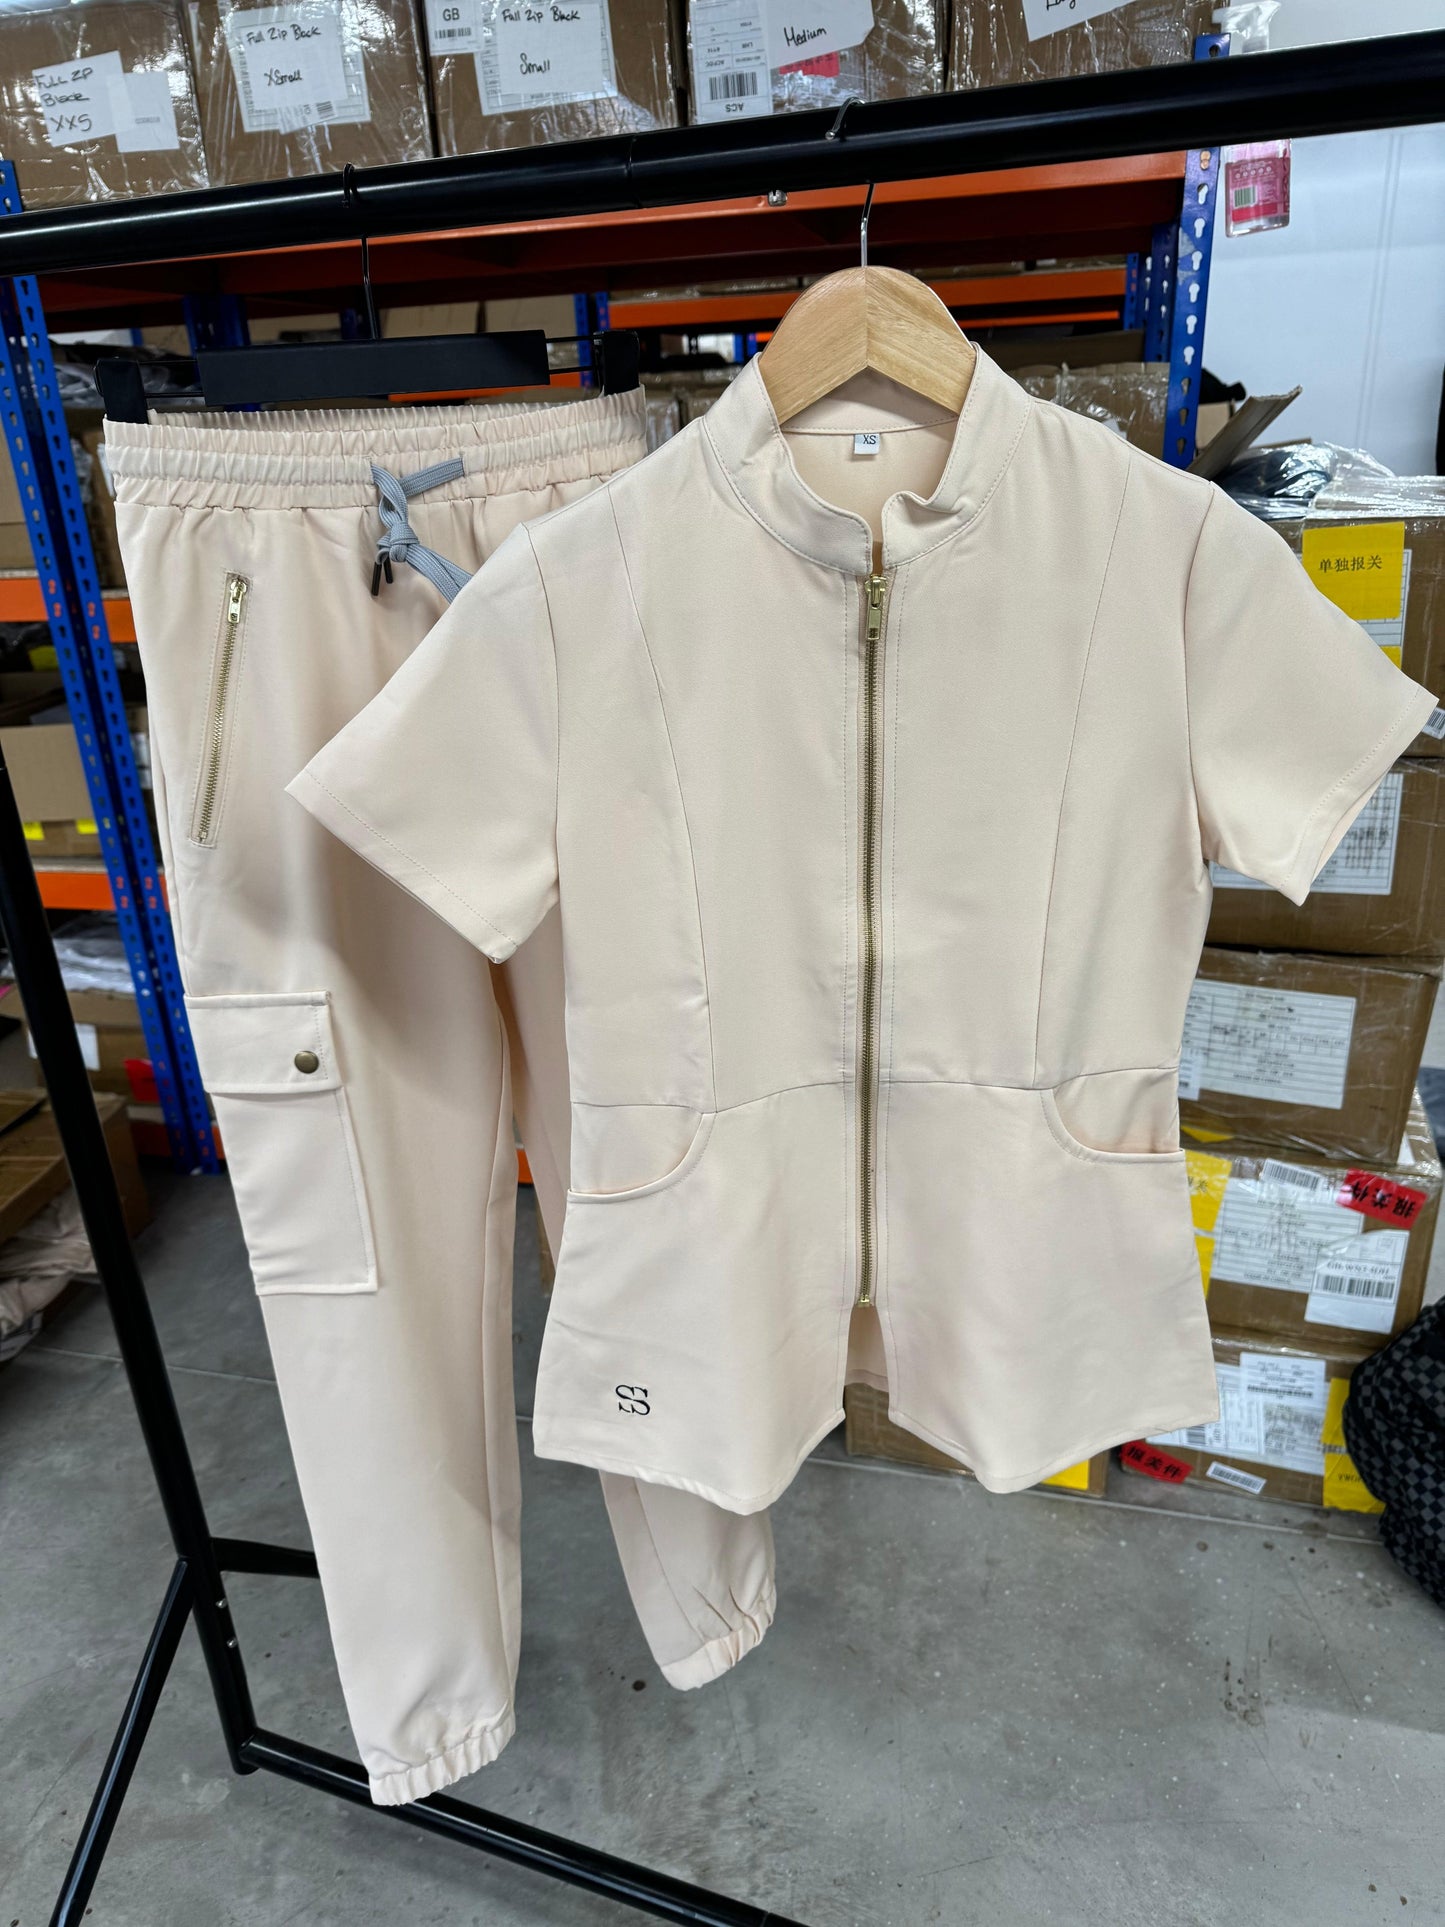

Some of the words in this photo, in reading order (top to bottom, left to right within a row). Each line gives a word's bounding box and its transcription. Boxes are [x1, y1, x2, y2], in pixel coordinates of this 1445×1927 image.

[442, 8, 460, 21] GB
[267, 27, 288, 41] Zip
[784, 26, 827, 47] Medium
[519, 52, 551, 75] Small
[725, 102, 744, 113] ACS
[50, 113, 93, 132] XXS
[863, 434, 877, 445] XS
[1319, 555, 1383, 573] 单独报关
